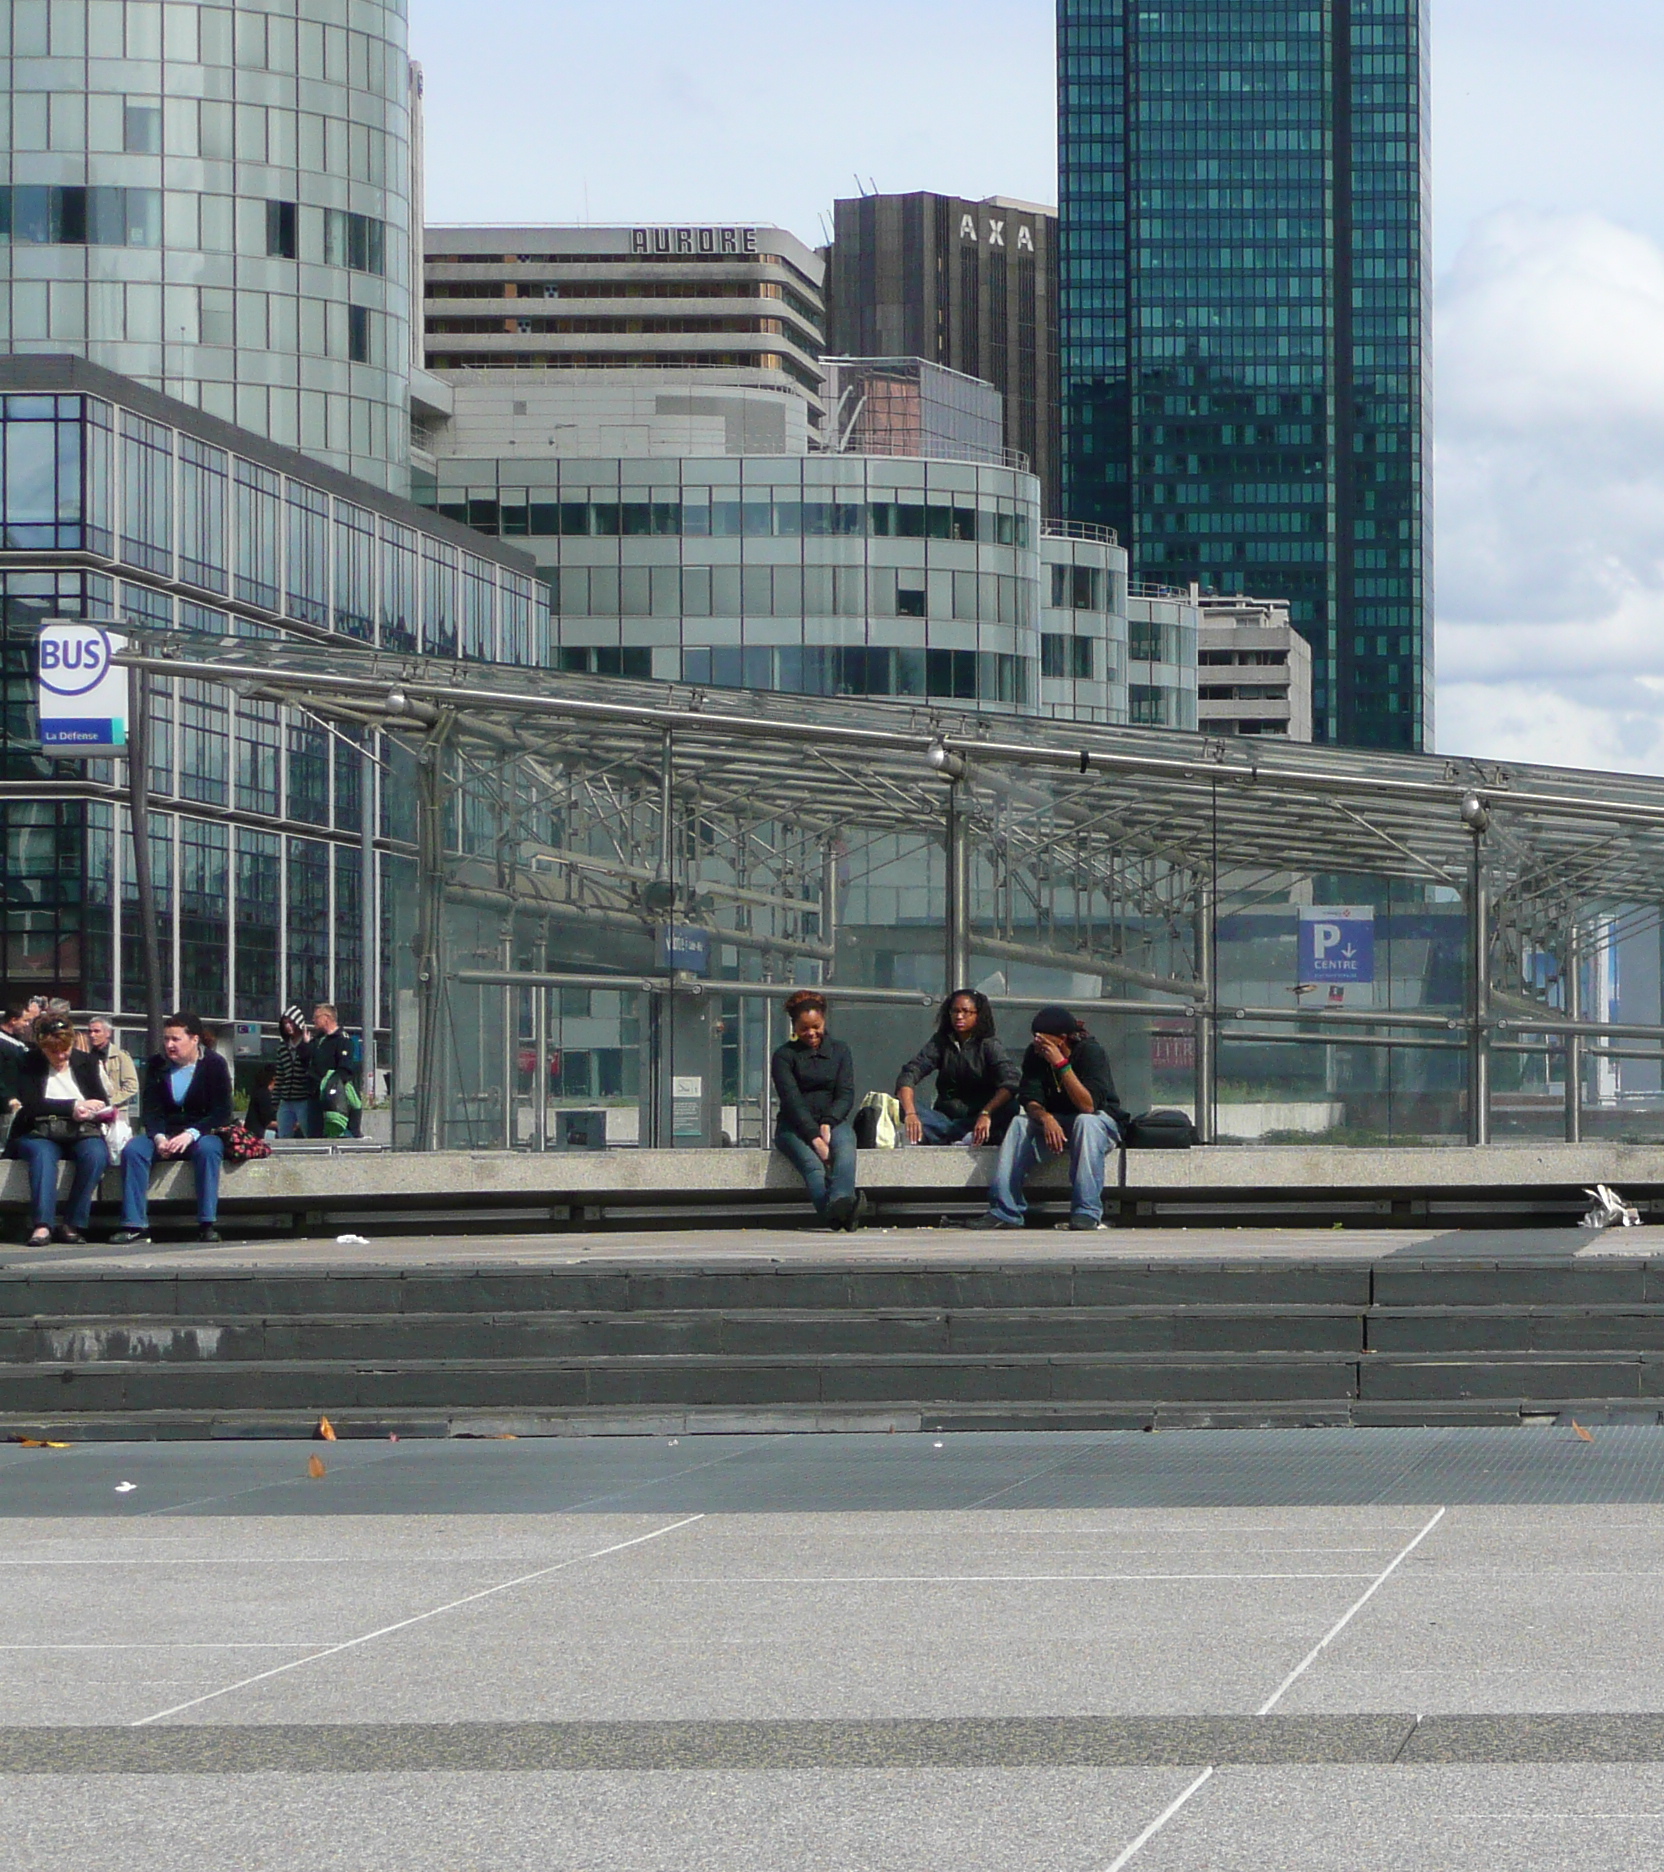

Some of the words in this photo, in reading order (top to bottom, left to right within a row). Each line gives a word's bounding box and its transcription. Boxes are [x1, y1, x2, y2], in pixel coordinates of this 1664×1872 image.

[631, 227, 758, 254] AURORE
[960, 213, 1035, 252] AXA
[41, 639, 101, 670] BUS
[45, 732, 57, 740] La
[1313, 923, 1341, 959] P
[1314, 960, 1358, 970] CENTRE
